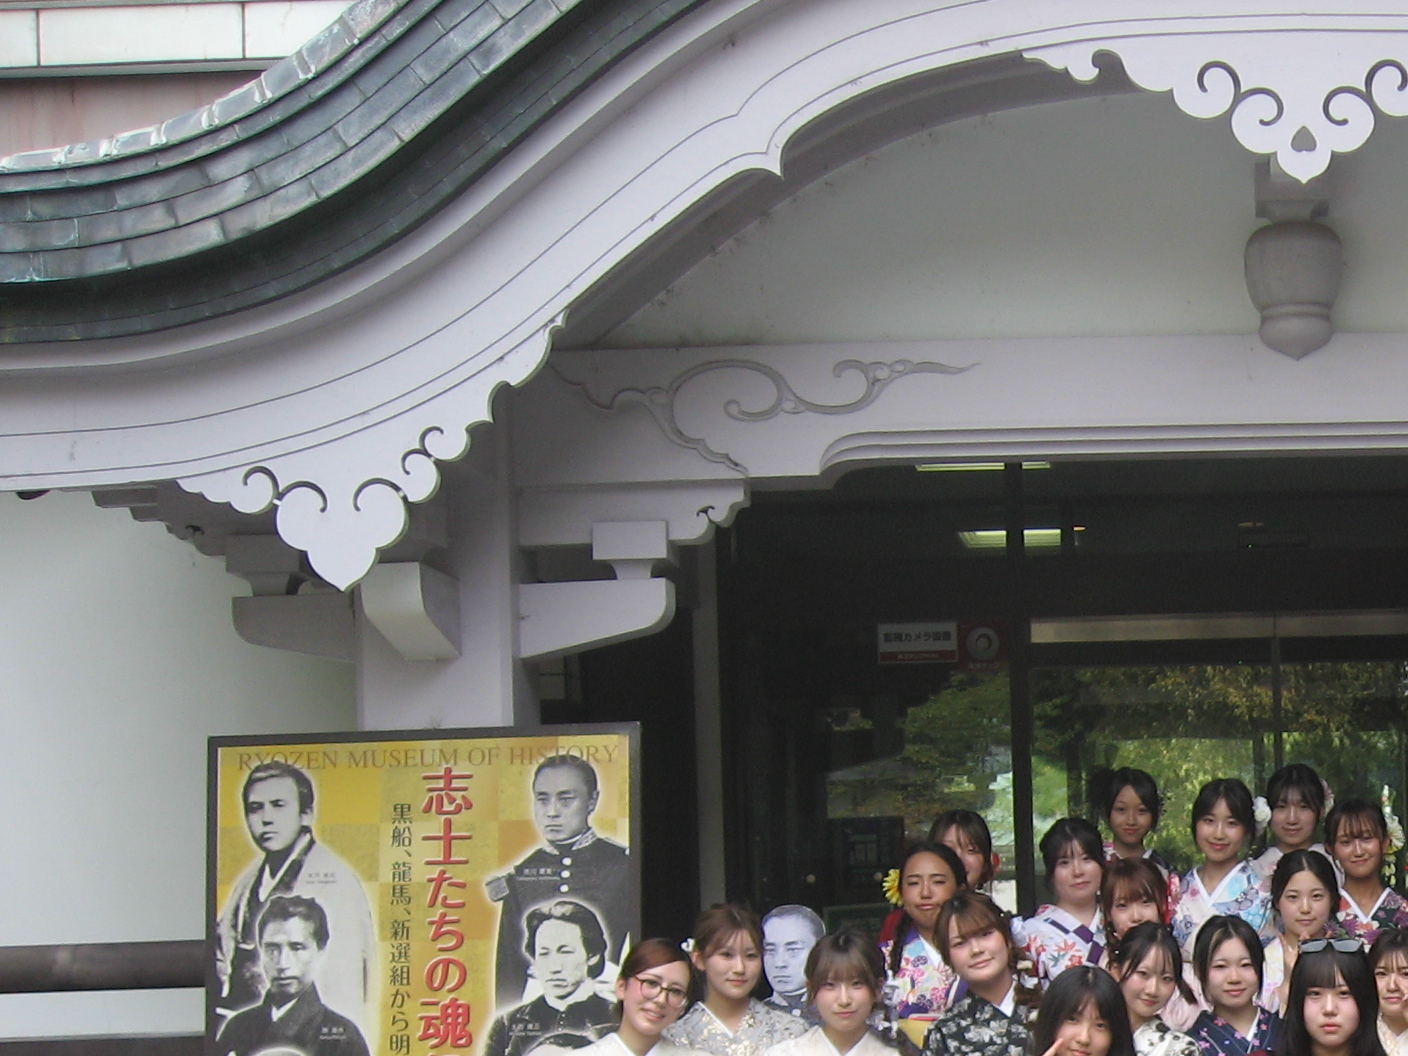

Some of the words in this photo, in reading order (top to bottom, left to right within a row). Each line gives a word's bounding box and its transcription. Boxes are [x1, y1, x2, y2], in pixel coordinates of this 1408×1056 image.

[237, 750, 338, 772] RYOZEN
[347, 747, 459, 770] MUSEUM
[467, 746, 500, 767] OF
[509, 744, 619, 766] HISTORY
